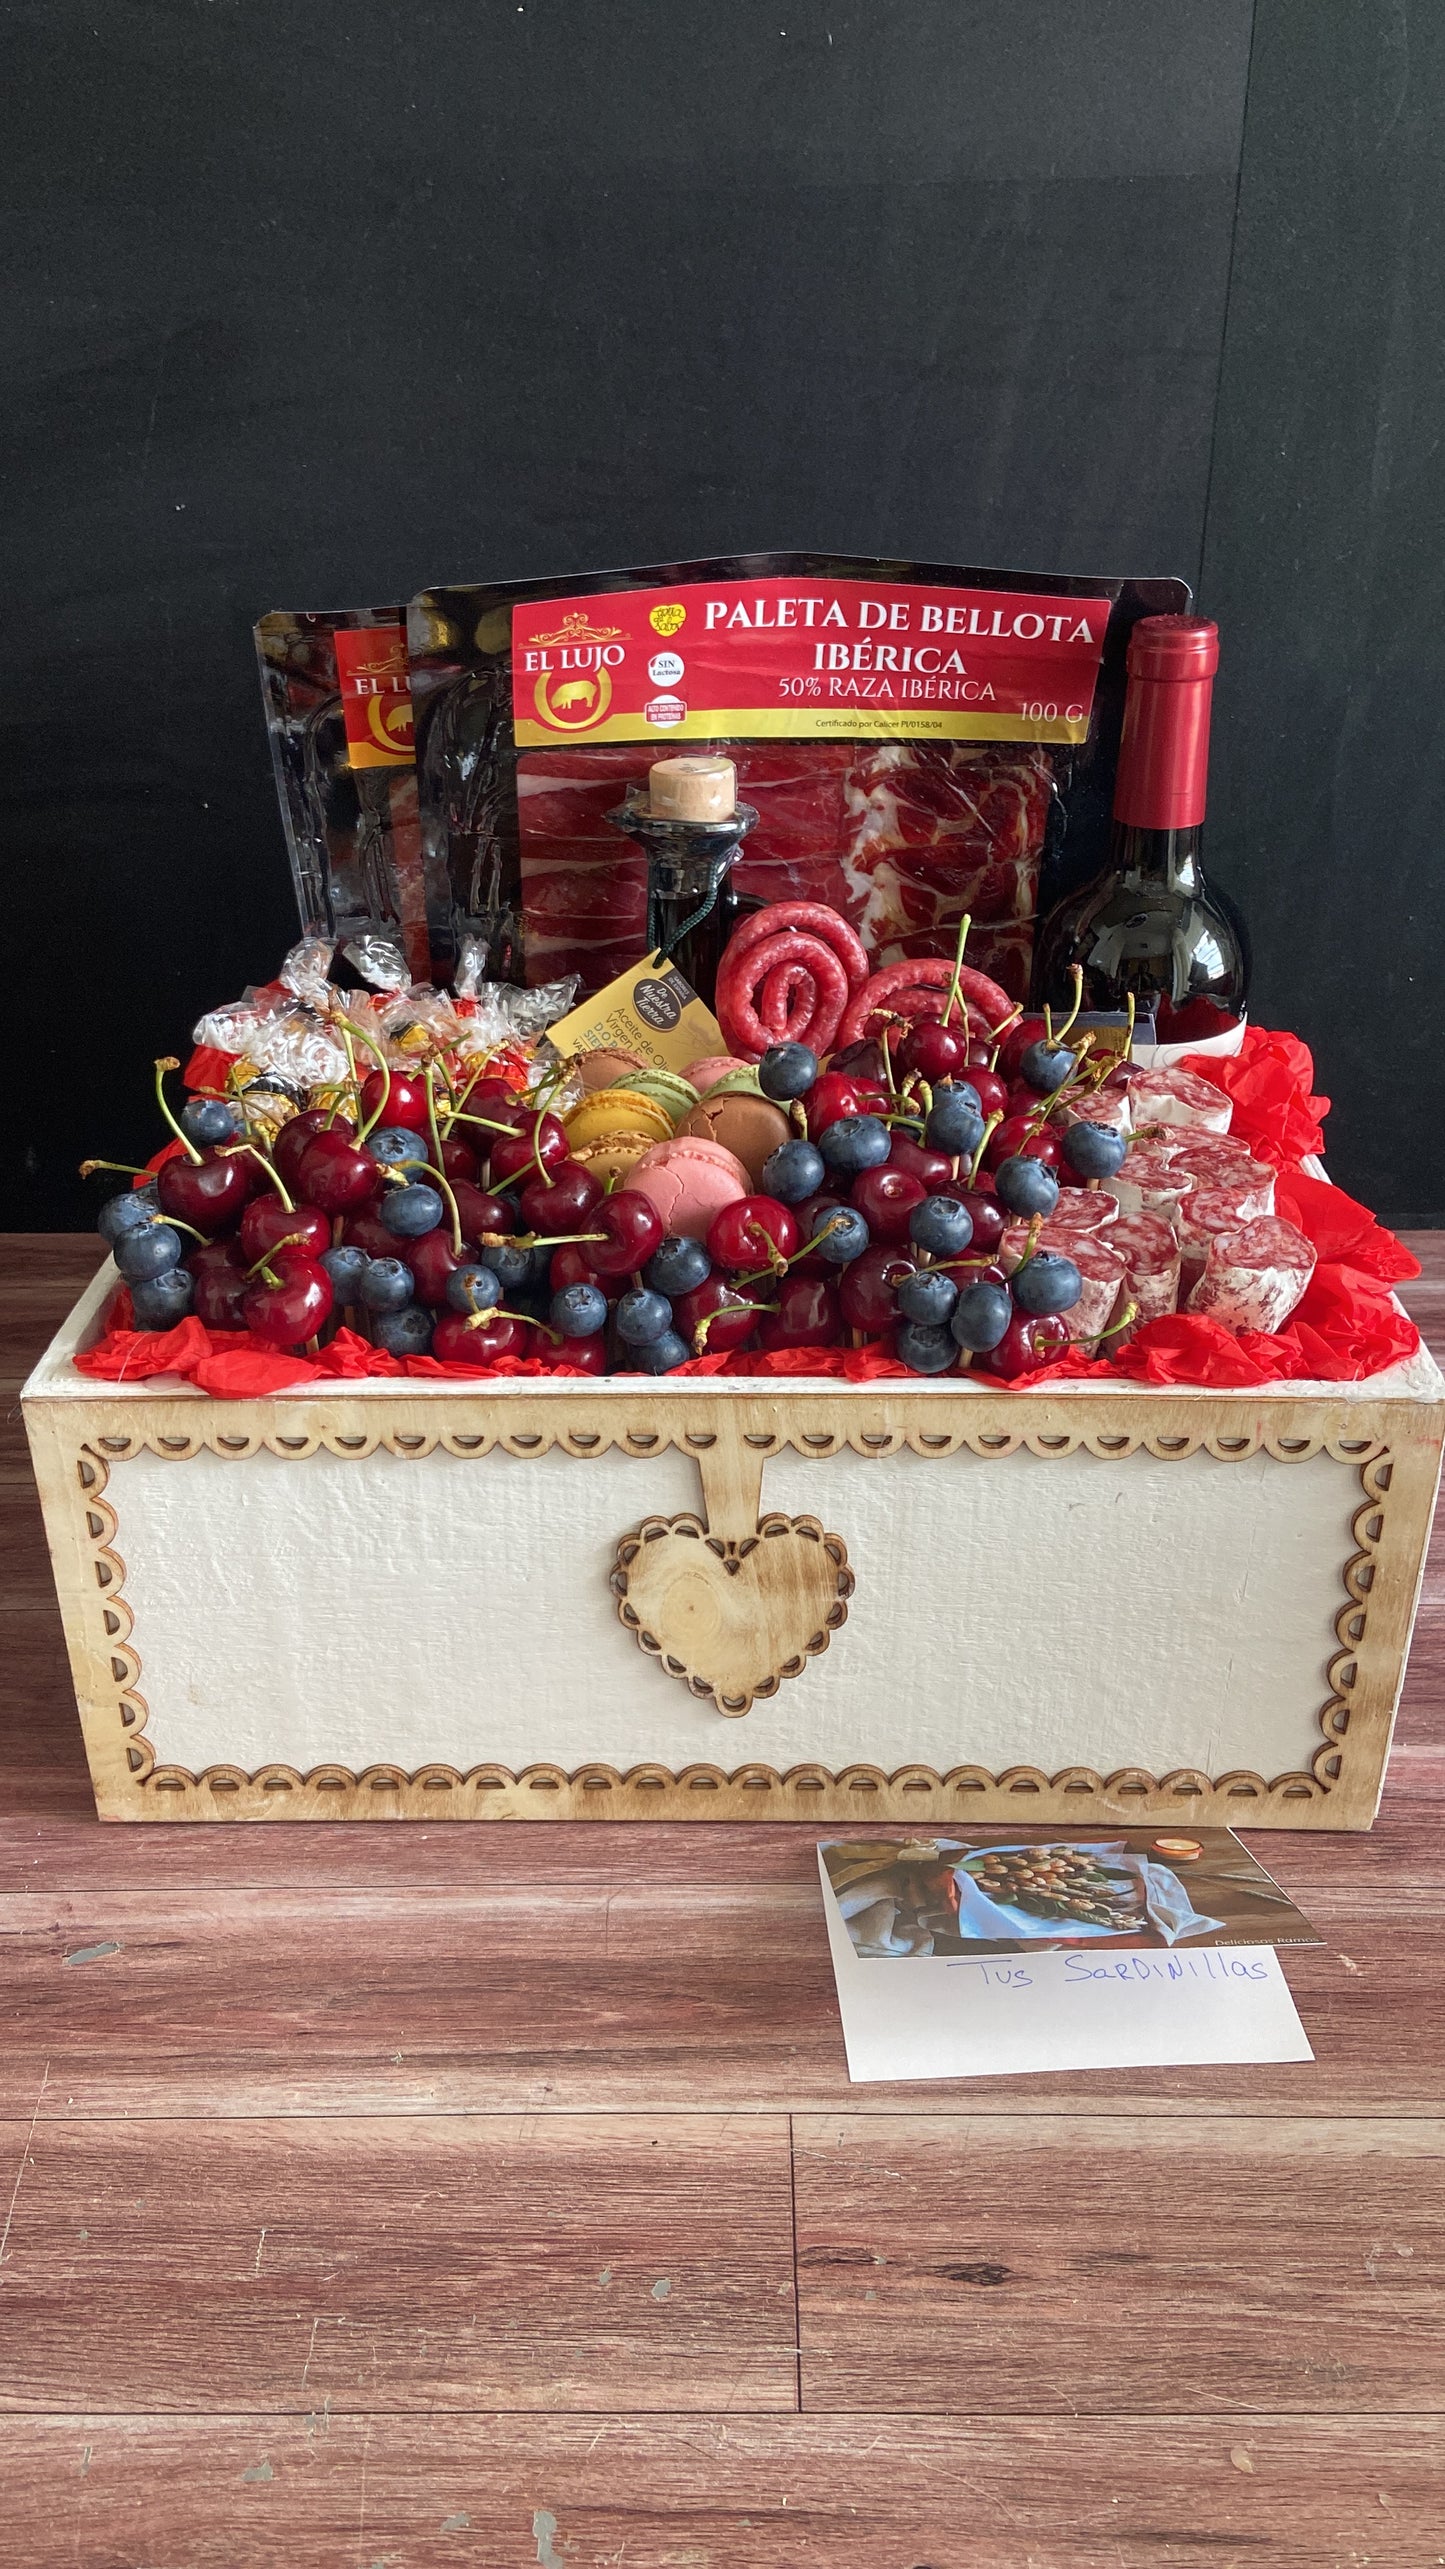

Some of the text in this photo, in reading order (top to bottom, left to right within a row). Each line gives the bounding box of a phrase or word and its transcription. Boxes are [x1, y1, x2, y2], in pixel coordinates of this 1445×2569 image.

[704, 599, 1095, 643] PALETA DE BELLOTA
[525, 645, 626, 673] EL LUJO
[658, 660, 675, 668] SIN
[813, 636, 968, 675] IBÉRICA
[355, 677, 385, 695] EL
[779, 676, 996, 701] 50% RAZA IBÉRICA
[815, 719, 857, 728] Certificado
[858, 721, 873, 729] por
[873, 720, 900, 729] Calicer
[1021, 702, 1084, 724] 100 G
[640, 984, 677, 1019] Nuestra
[657, 987, 668, 999] De
[636, 996, 664, 1025] Tierra
[606, 1013, 634, 1049] Virgen
[614, 1008, 642, 1040] Aceite
[640, 1039, 654, 1056] de
[946, 1958, 1034, 1989] Tus
